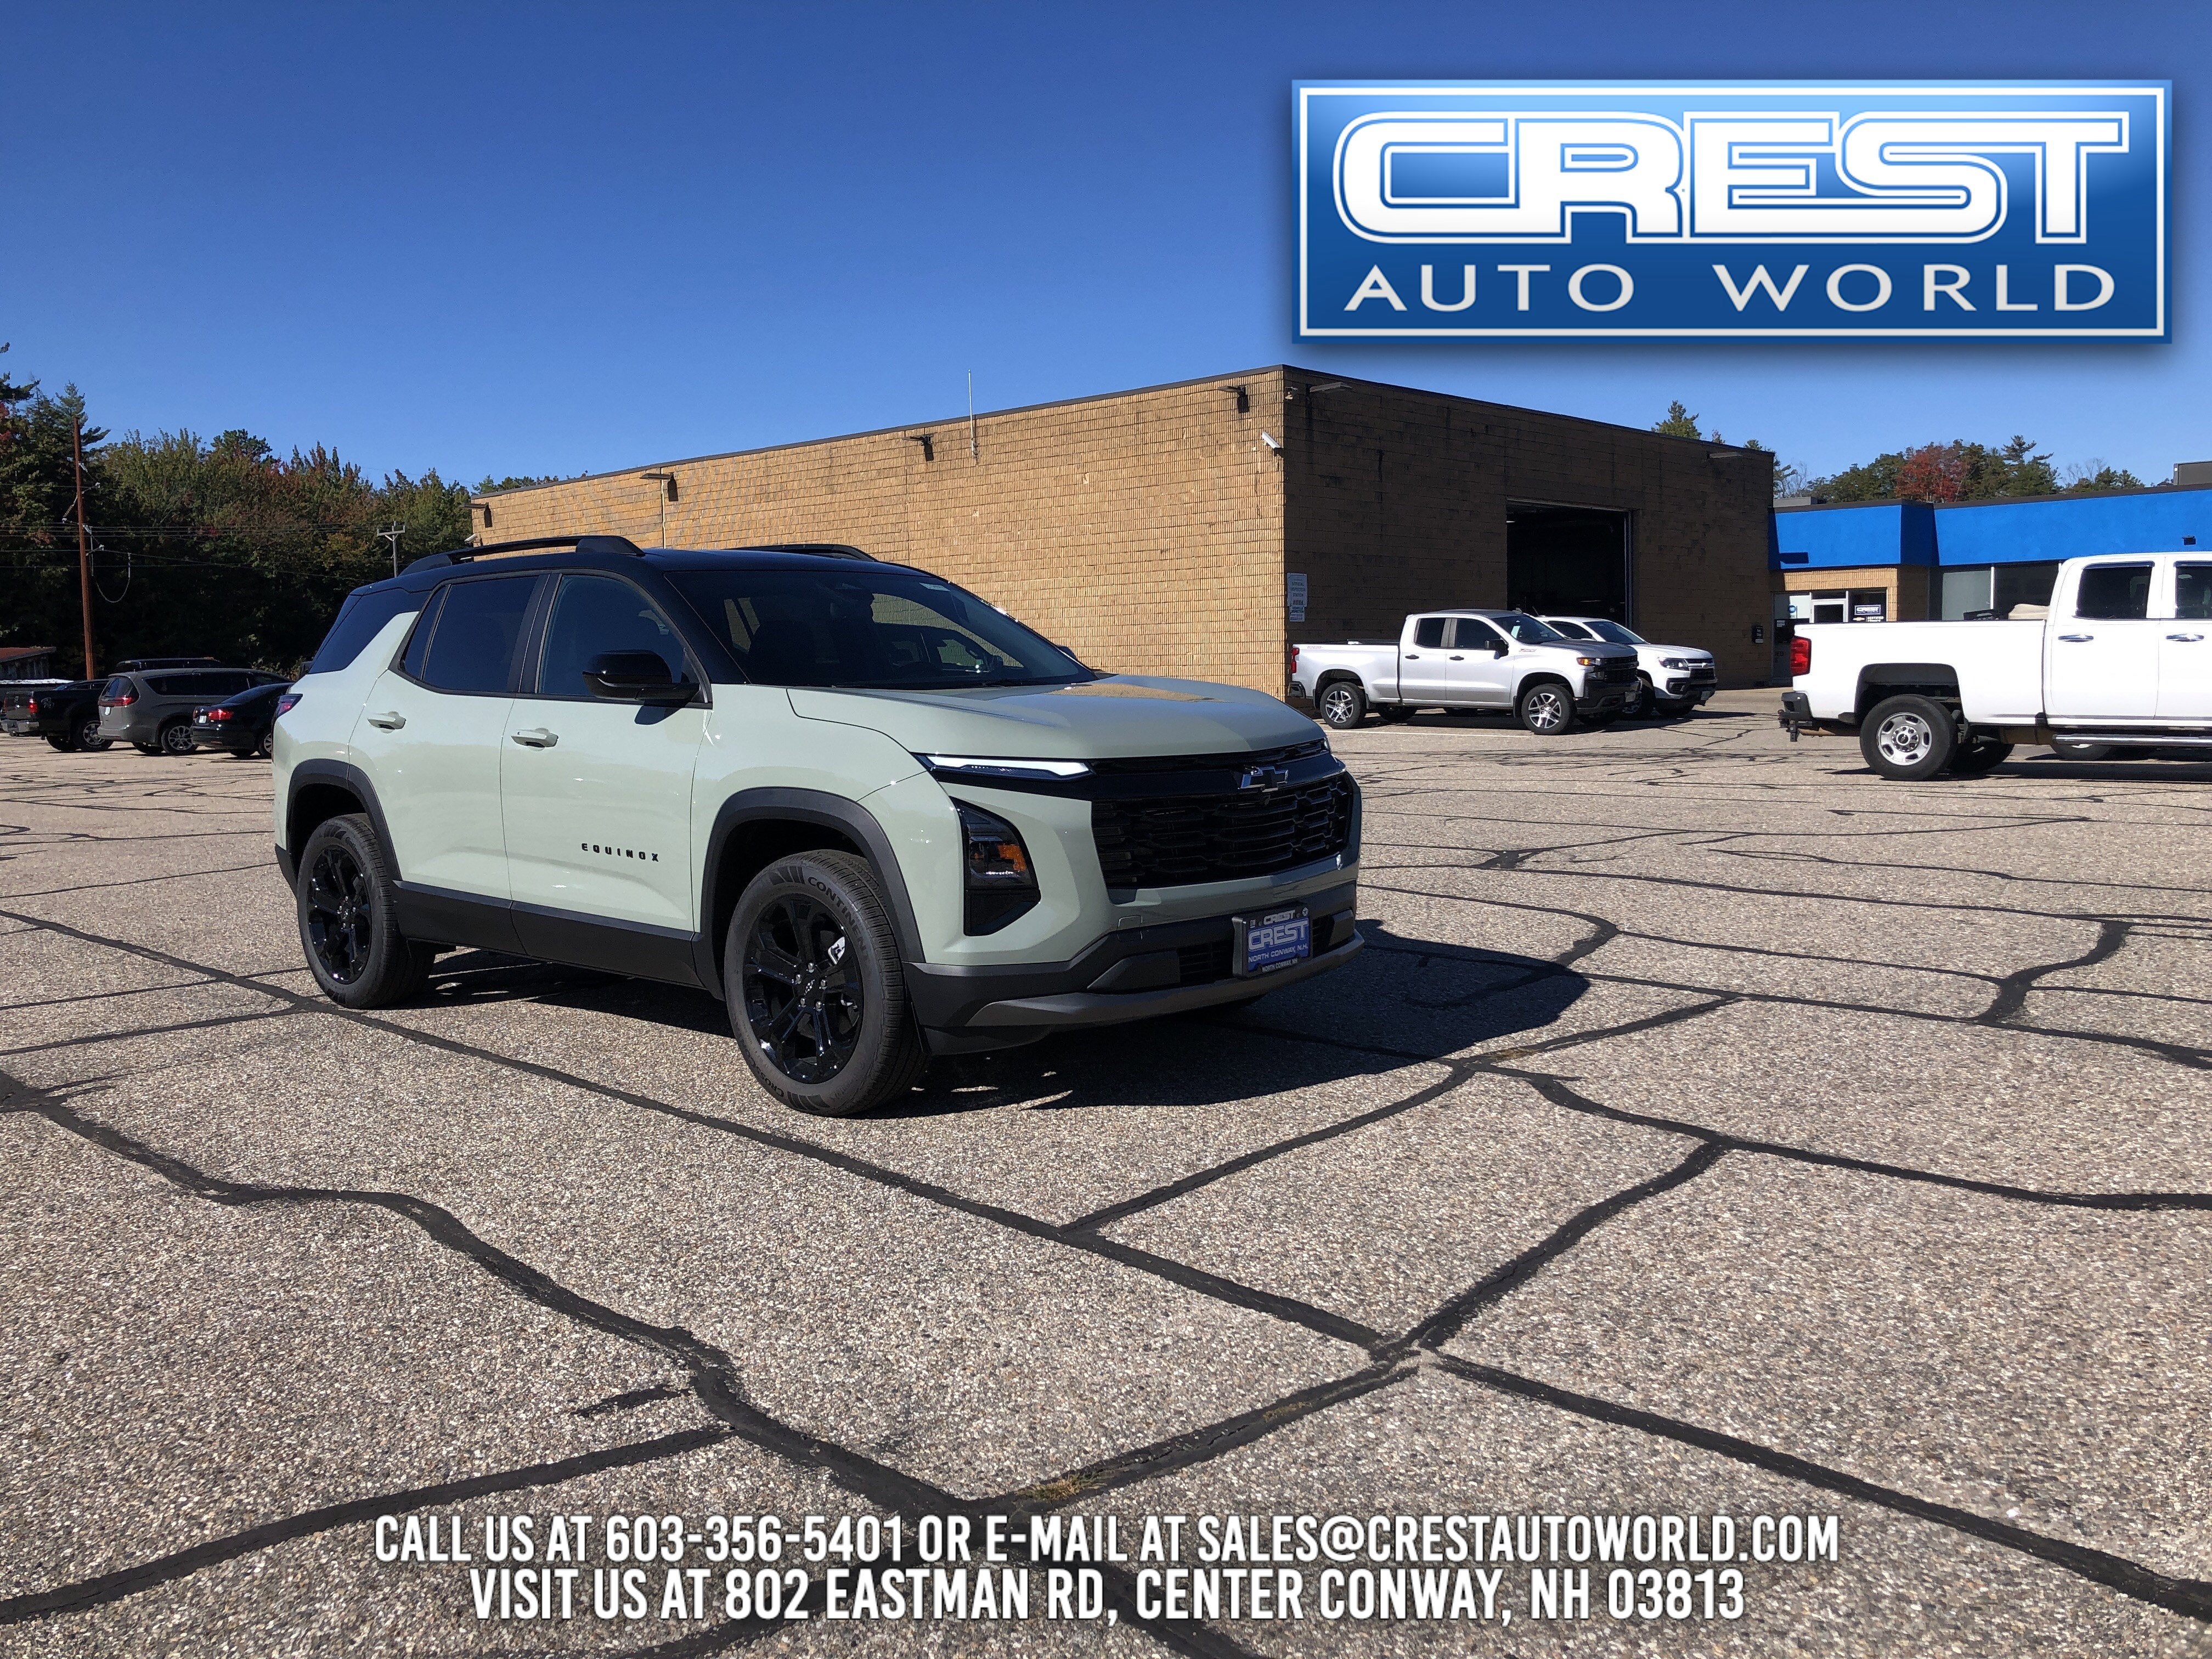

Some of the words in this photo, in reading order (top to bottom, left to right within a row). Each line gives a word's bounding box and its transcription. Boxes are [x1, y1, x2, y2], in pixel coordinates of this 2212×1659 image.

[582, 843, 659, 862] EQUINOX
[1263, 910, 1295, 925] CREST
[1248, 918, 1309, 951] CREST
[1248, 952, 1269, 963] NORTH
[1271, 946, 1296, 958] CONWAY,
